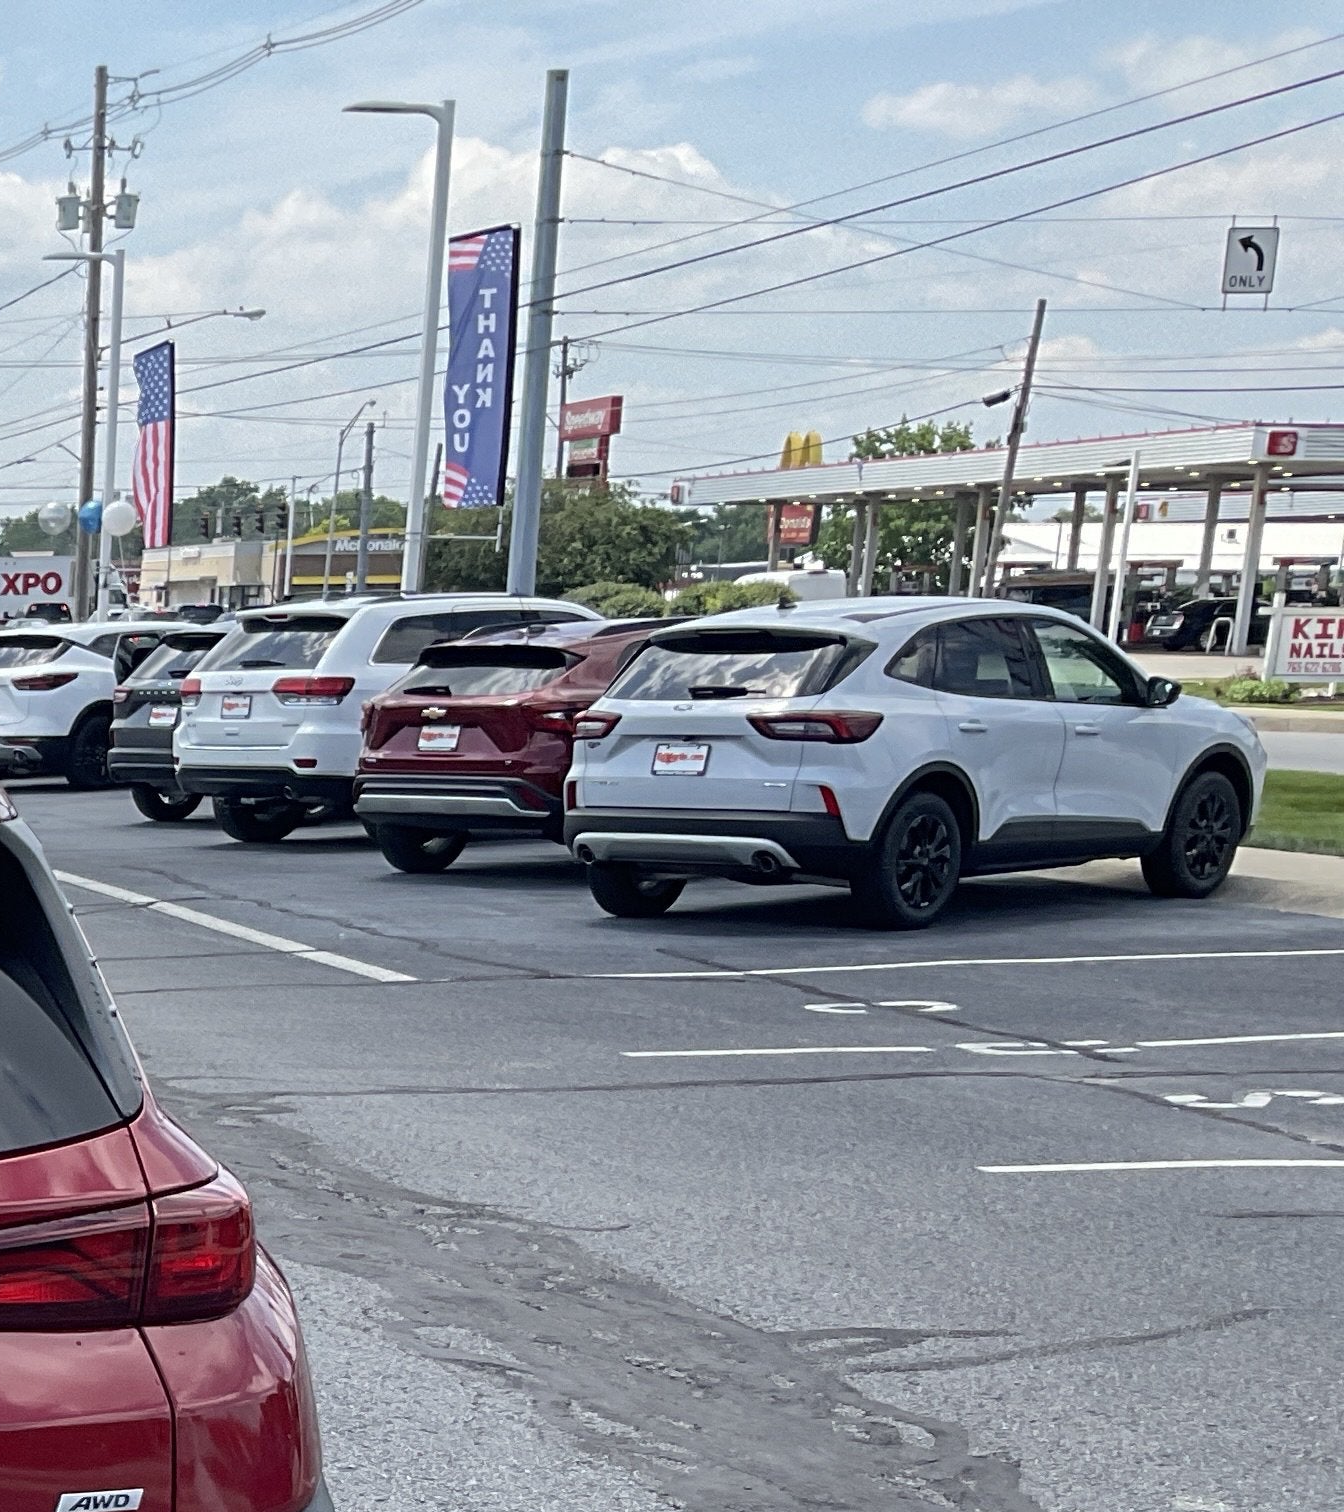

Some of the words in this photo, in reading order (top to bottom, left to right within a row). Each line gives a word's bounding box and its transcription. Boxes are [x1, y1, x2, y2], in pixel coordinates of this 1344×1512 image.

[1228, 275, 1265, 288] ONLY
[0, 571, 63, 596] XPO
[1289, 642, 1344, 659] NAIL
[68, 1494, 130, 1512] AWD
